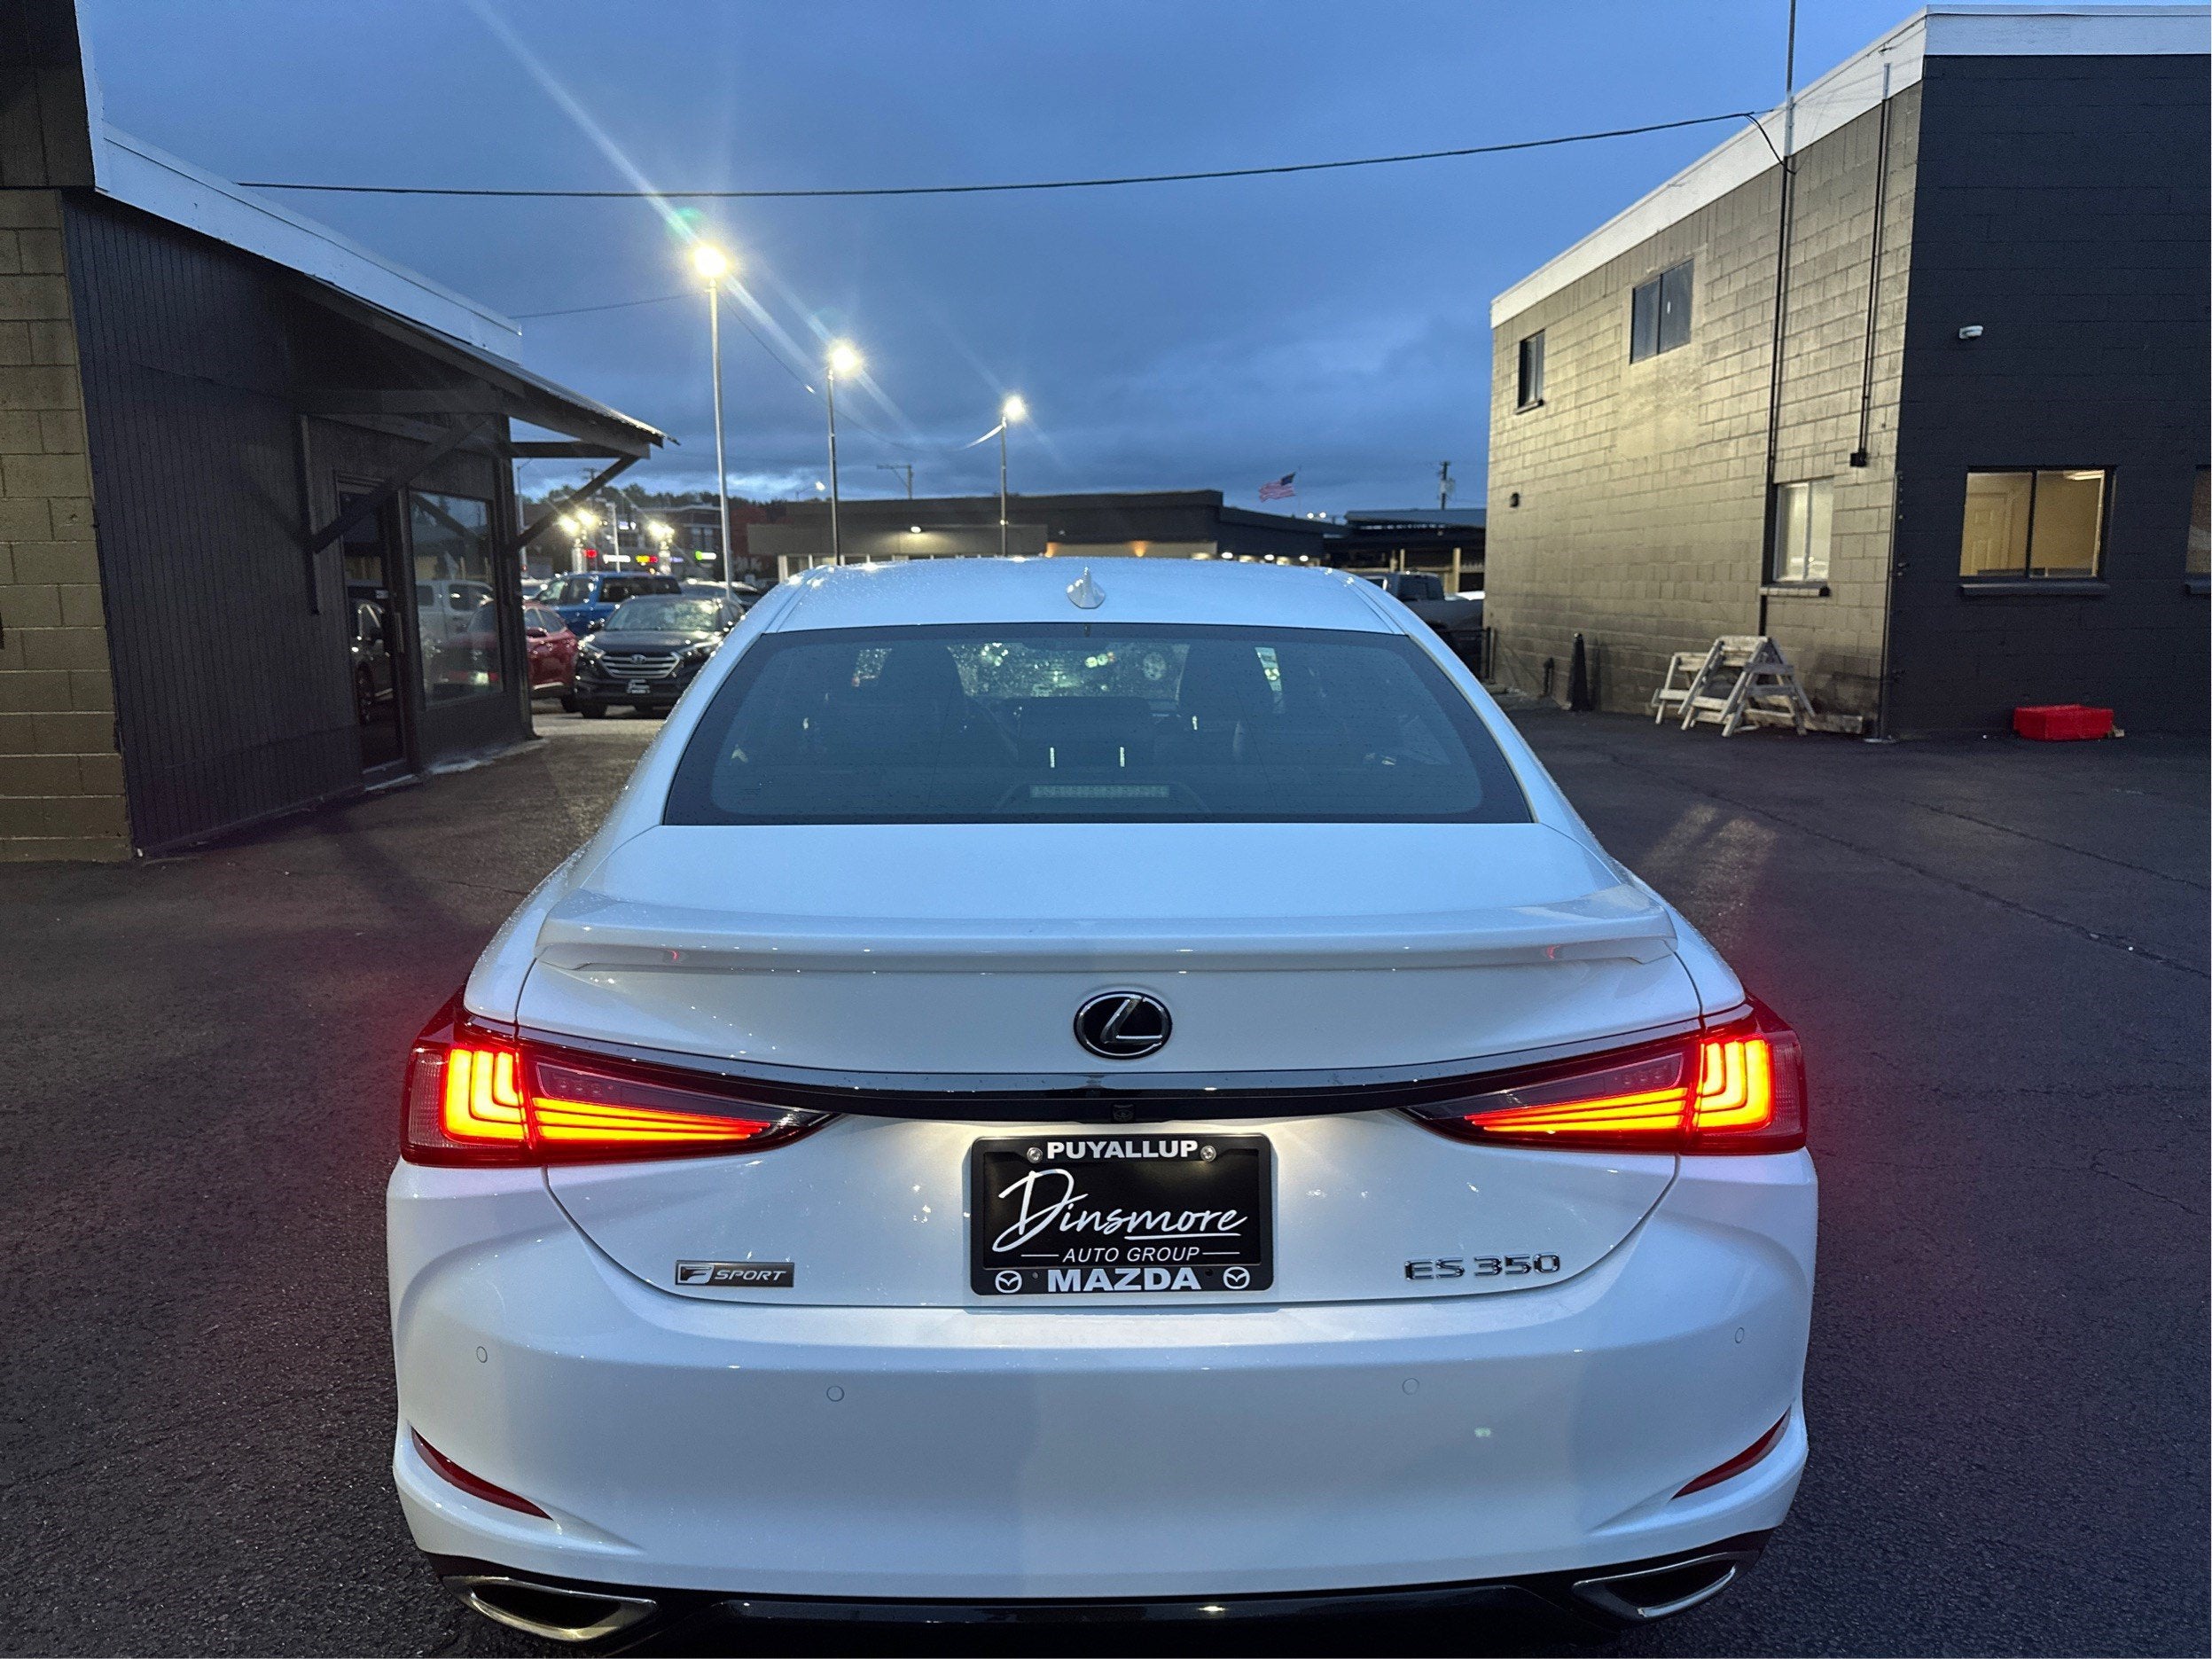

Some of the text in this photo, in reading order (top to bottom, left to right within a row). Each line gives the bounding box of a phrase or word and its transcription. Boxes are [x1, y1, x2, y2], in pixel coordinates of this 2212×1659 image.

[1047, 1140, 1198, 1159] PUYALLUP
[992, 1168, 1248, 1252] Dinsmore
[1062, 1247, 1200, 1263] AUTO GROUP
[1405, 1253, 1560, 1279] ES 350
[715, 1269, 786, 1281] SPORT
[1047, 1267, 1202, 1292] MAZDA
